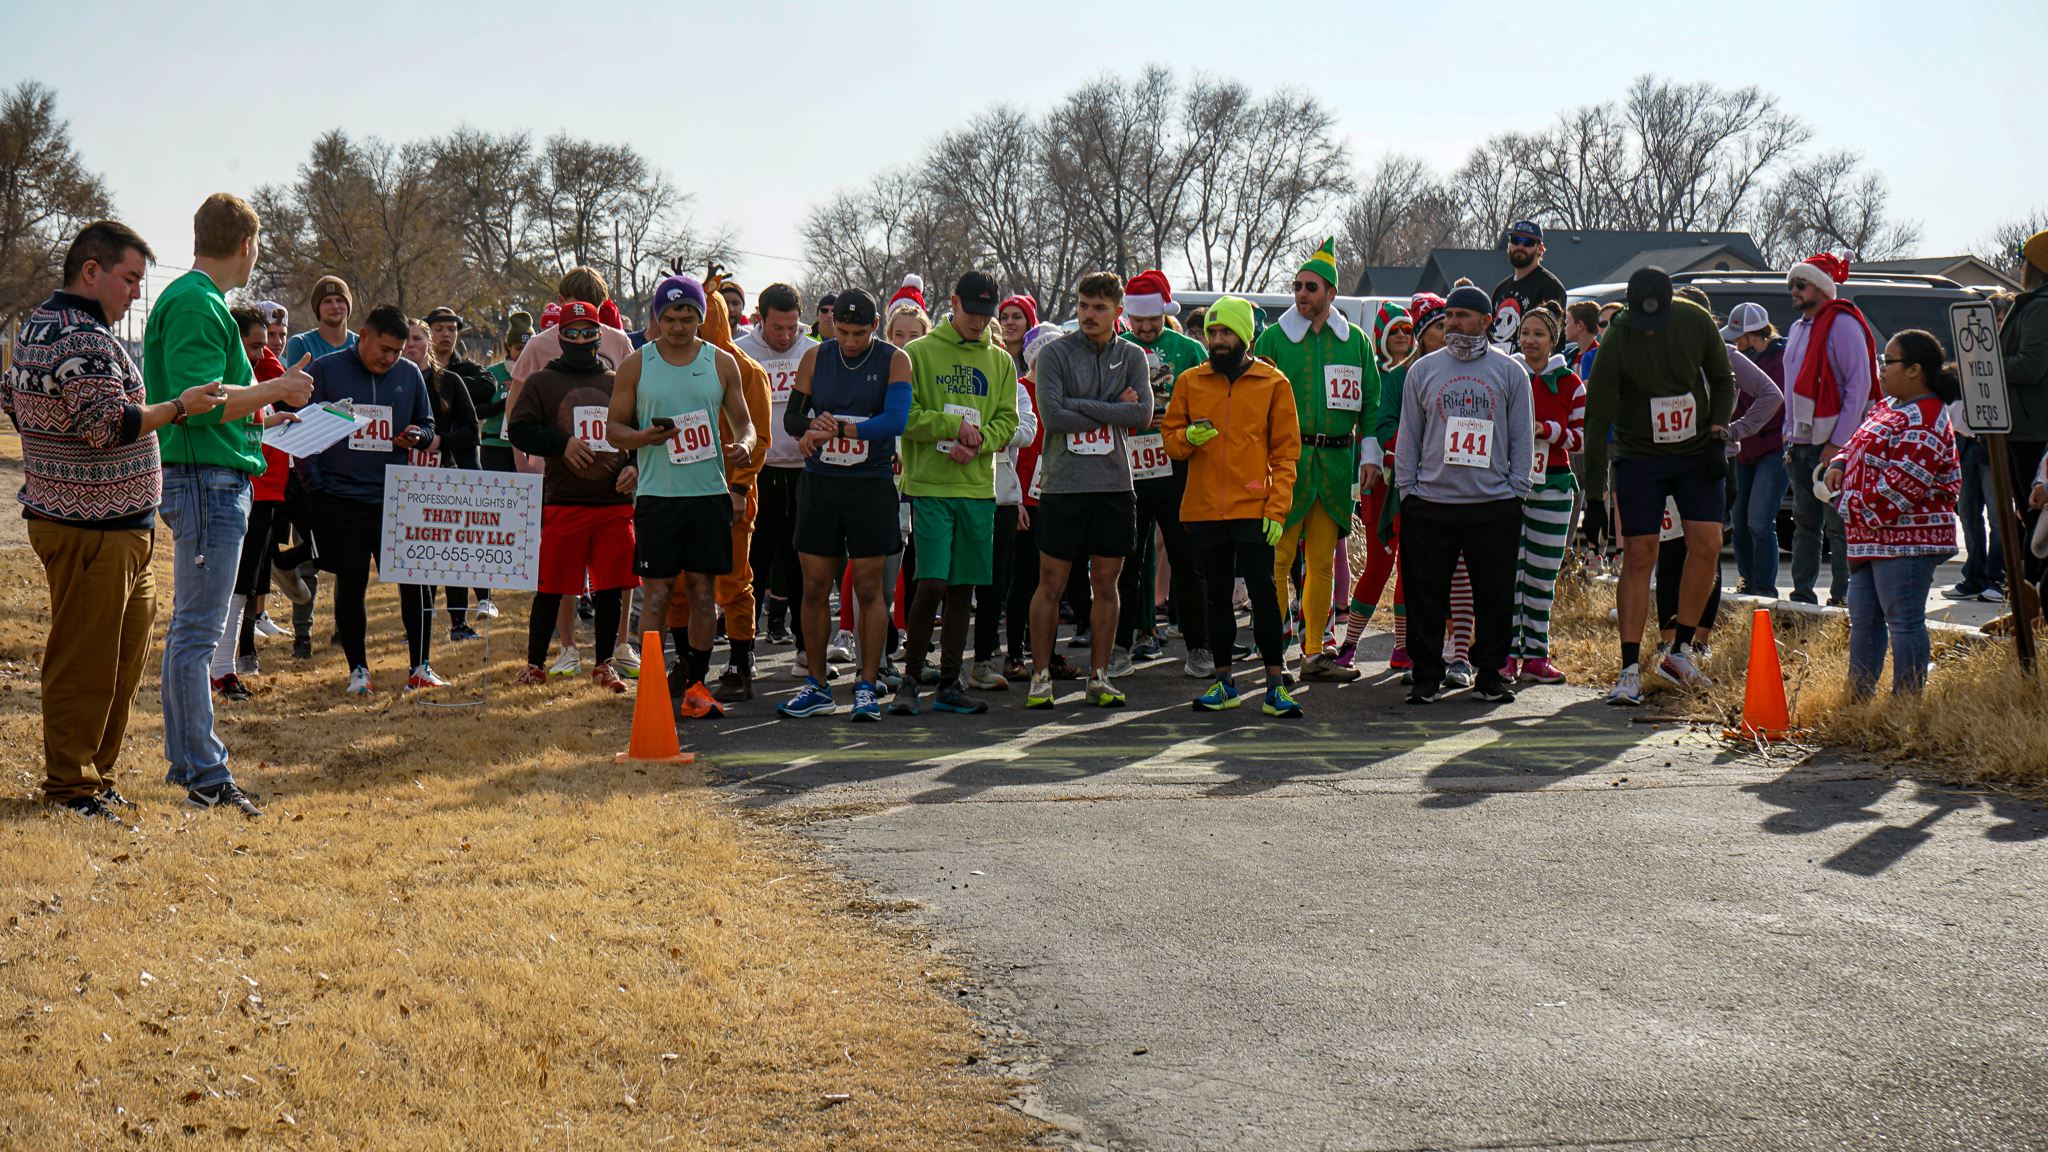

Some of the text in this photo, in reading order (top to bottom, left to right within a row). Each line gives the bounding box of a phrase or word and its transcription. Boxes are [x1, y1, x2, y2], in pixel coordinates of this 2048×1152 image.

[952, 364, 972, 376] THE
[1968, 360, 1993, 377] YIELD
[936, 374, 972, 385] NORTH
[947, 385, 972, 394] FACE
[1330, 378, 1360, 401] 126
[1978, 383, 1990, 399] TO
[1657, 407, 1693, 433] 197
[1976, 405, 1999, 421] PEDS
[354, 419, 389, 441] 140
[580, 420, 608, 441] 10
[672, 424, 711, 454] 190
[1449, 431, 1487, 456] 141
[1131, 447, 1168, 469] 195
[407, 493, 519, 509] PROFESSIONAL LIGHTS BY
[422, 508, 501, 528] THAT JUAN
[405, 526, 516, 546] LIGHT GUY LLC
[406, 544, 513, 565] 620-655-9503
